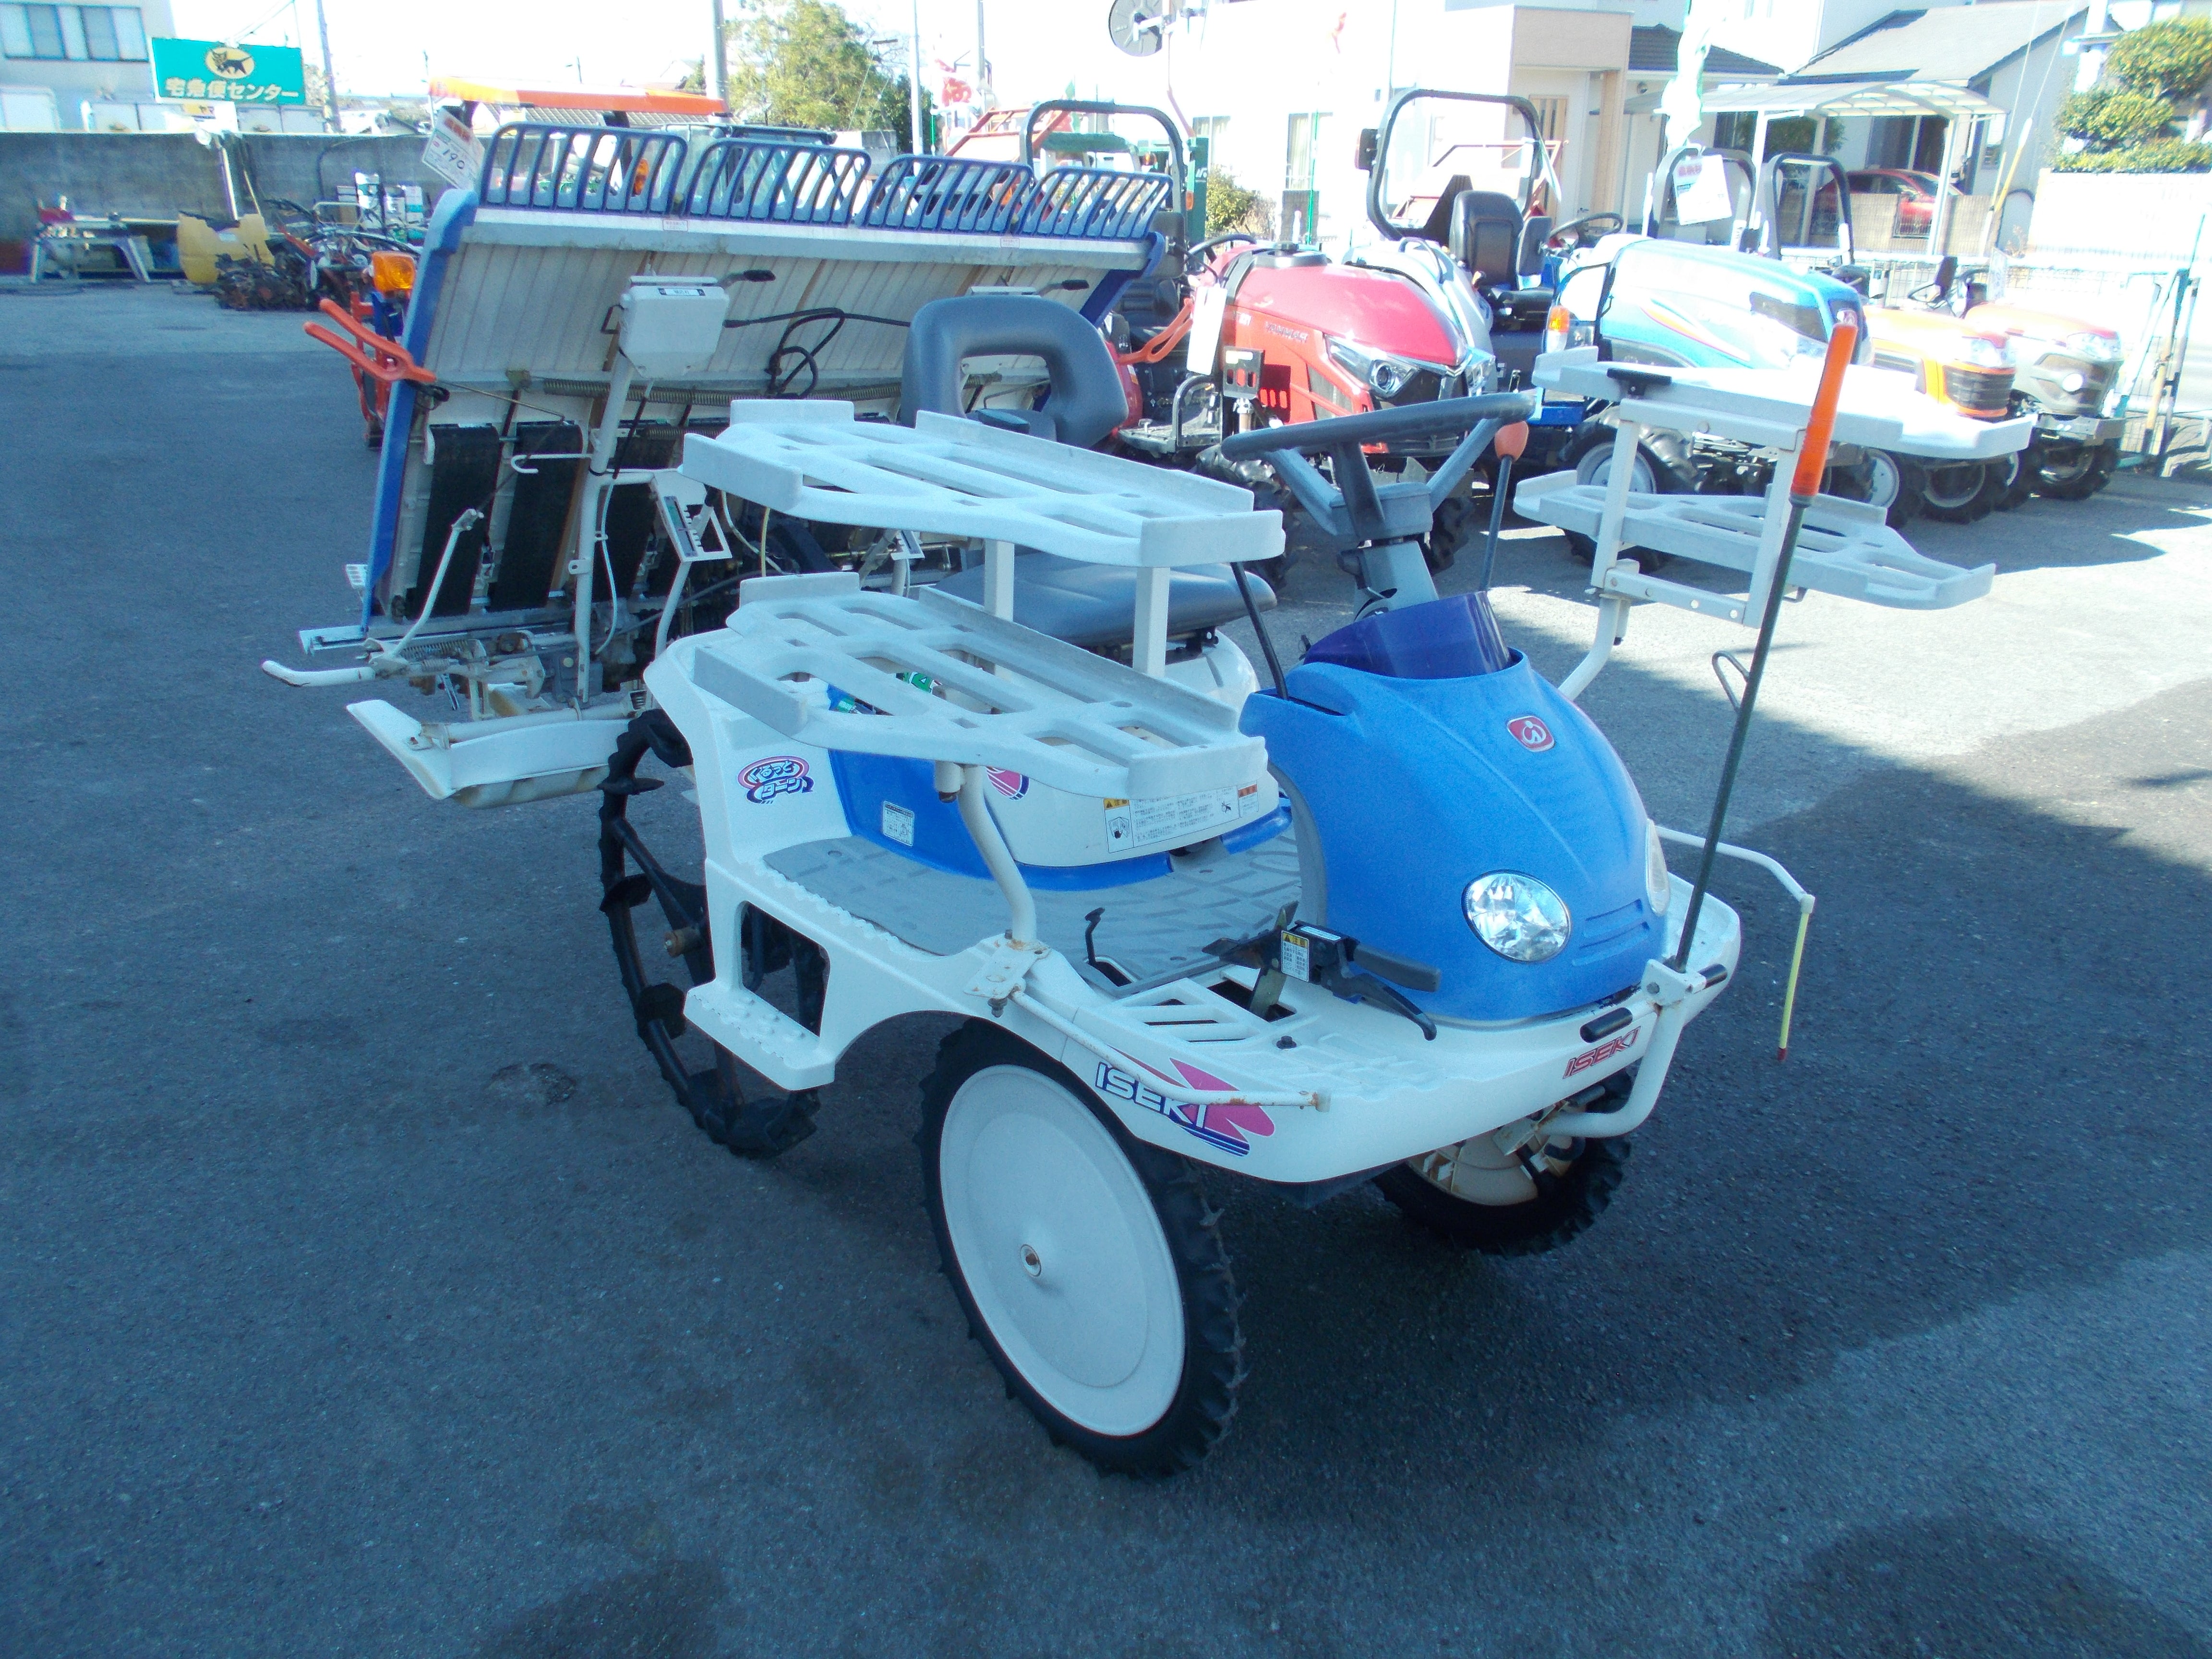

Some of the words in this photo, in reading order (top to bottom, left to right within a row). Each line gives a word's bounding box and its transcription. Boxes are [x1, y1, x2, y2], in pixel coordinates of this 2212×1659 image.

[748, 760, 794, 781] くるっと
[761, 778, 803, 800] ターン
[1563, 1026, 1641, 1079] ISEKI
[1095, 1061, 1208, 1129] ISEKI
